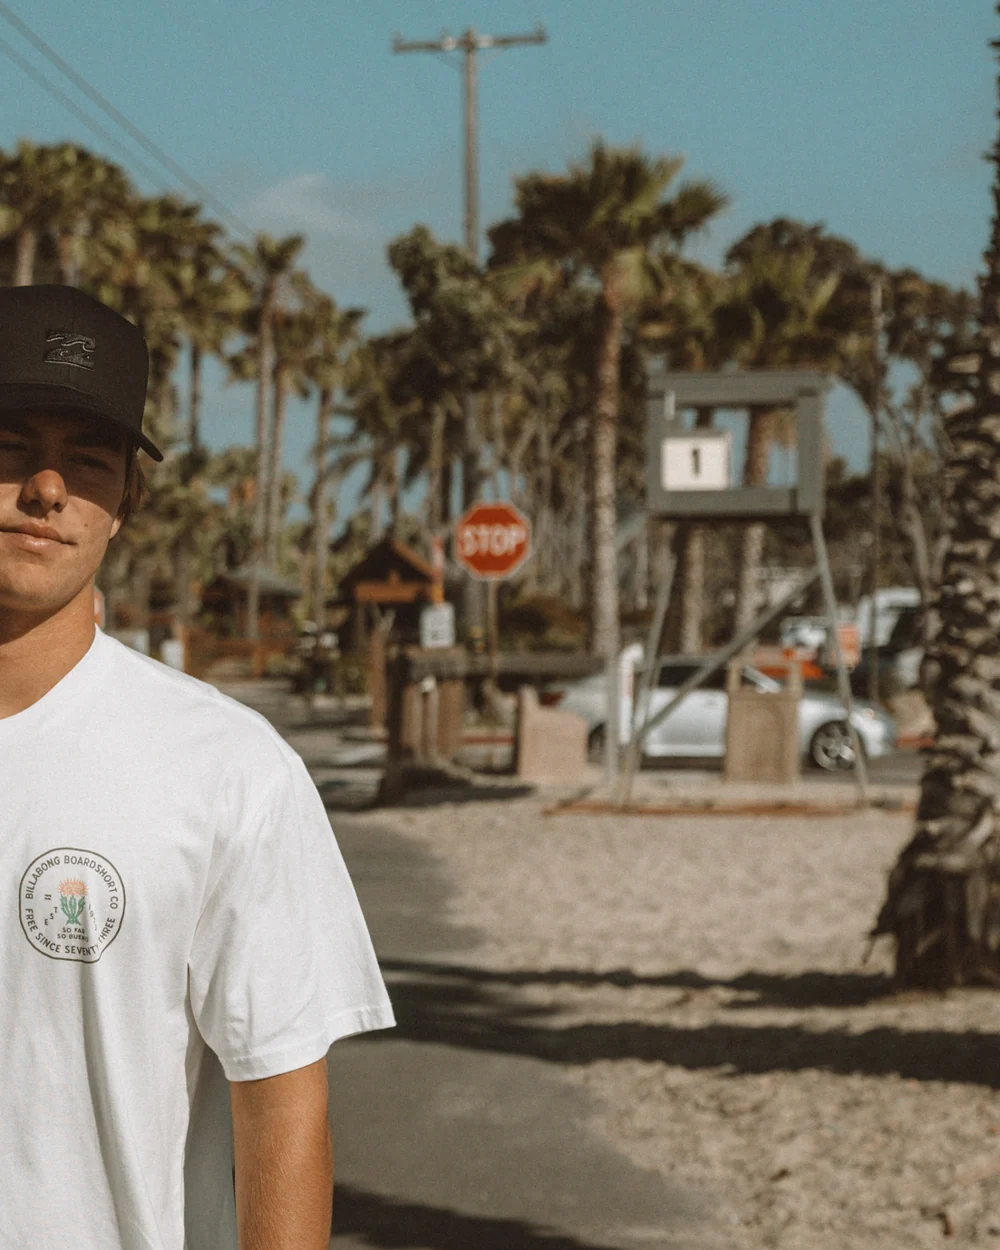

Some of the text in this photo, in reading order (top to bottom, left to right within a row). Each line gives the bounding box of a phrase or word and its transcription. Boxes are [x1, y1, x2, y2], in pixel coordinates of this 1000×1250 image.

[691, 447, 702, 478] 1
[463, 524, 526, 557] STOP
[25, 855, 119, 909] BILLABONG BOARDSHORT CO
[25, 908, 116, 956] FREE SINCE SEVENTY THREE
[68, 933, 89, 943] BUENO
[74, 927, 86, 935] FAR
